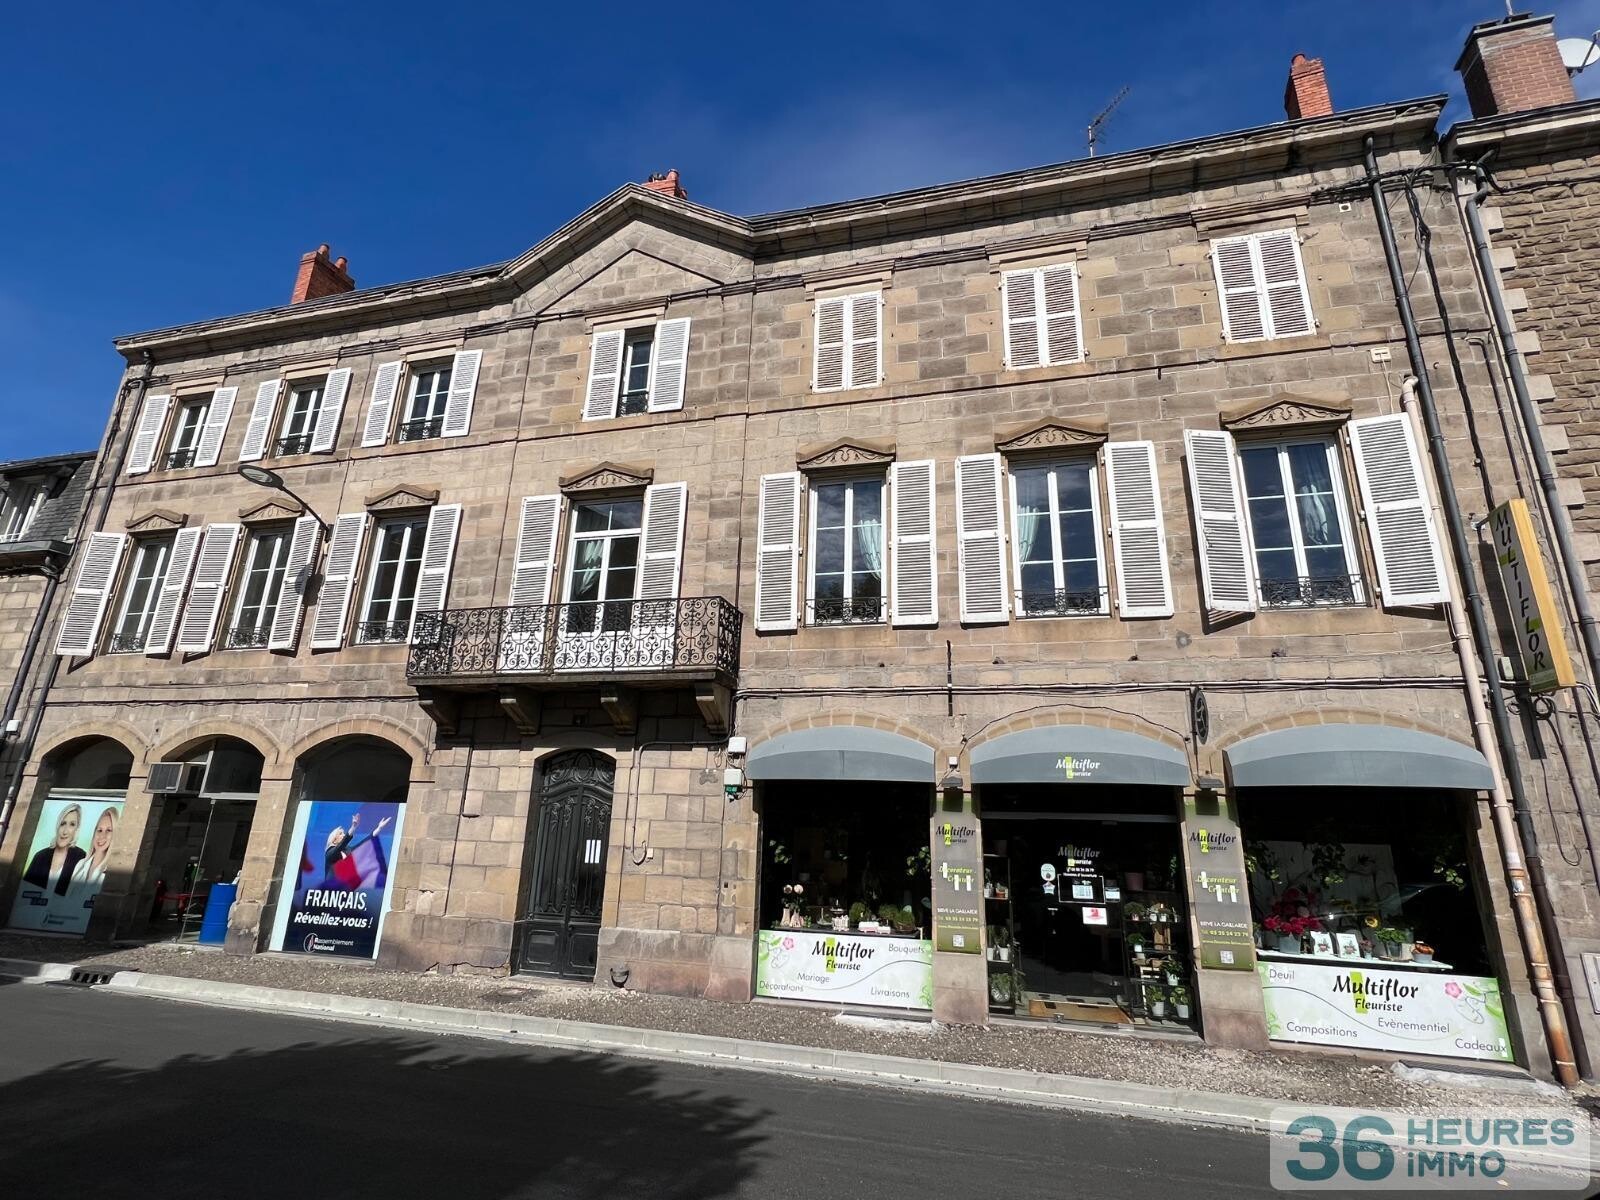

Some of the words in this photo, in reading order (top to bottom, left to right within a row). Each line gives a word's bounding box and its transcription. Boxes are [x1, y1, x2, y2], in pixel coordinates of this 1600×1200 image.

[1496, 509, 1546, 671] MULTIFLOR
[1055, 758, 1100, 771] Multiflor
[936, 825, 976, 837] Multiflor
[1190, 831, 1237, 845] Multiflor
[1058, 846, 1100, 859] Multiflor
[1197, 875, 1237, 884] Dcorateur
[305, 889, 367, 911] FRANÇAIS,
[294, 911, 367, 928] Réveillez-vous
[811, 940, 875, 962] Multiflor
[888, 943, 925, 954] Bouquets
[826, 959, 861, 971] Fleuriste
[798, 972, 830, 983] Mariage
[1269, 968, 1295, 980] Deuil
[759, 980, 804, 992] Décorations
[870, 986, 910, 998] Livraisons
[1332, 974, 1419, 1001] Multiflor
[1355, 998, 1403, 1012] Fleuriste
[1286, 1021, 1358, 1038] Compositions
[1378, 1017, 1450, 1033] Evènementiel
[1455, 1038, 1506, 1052] Cadeaux
